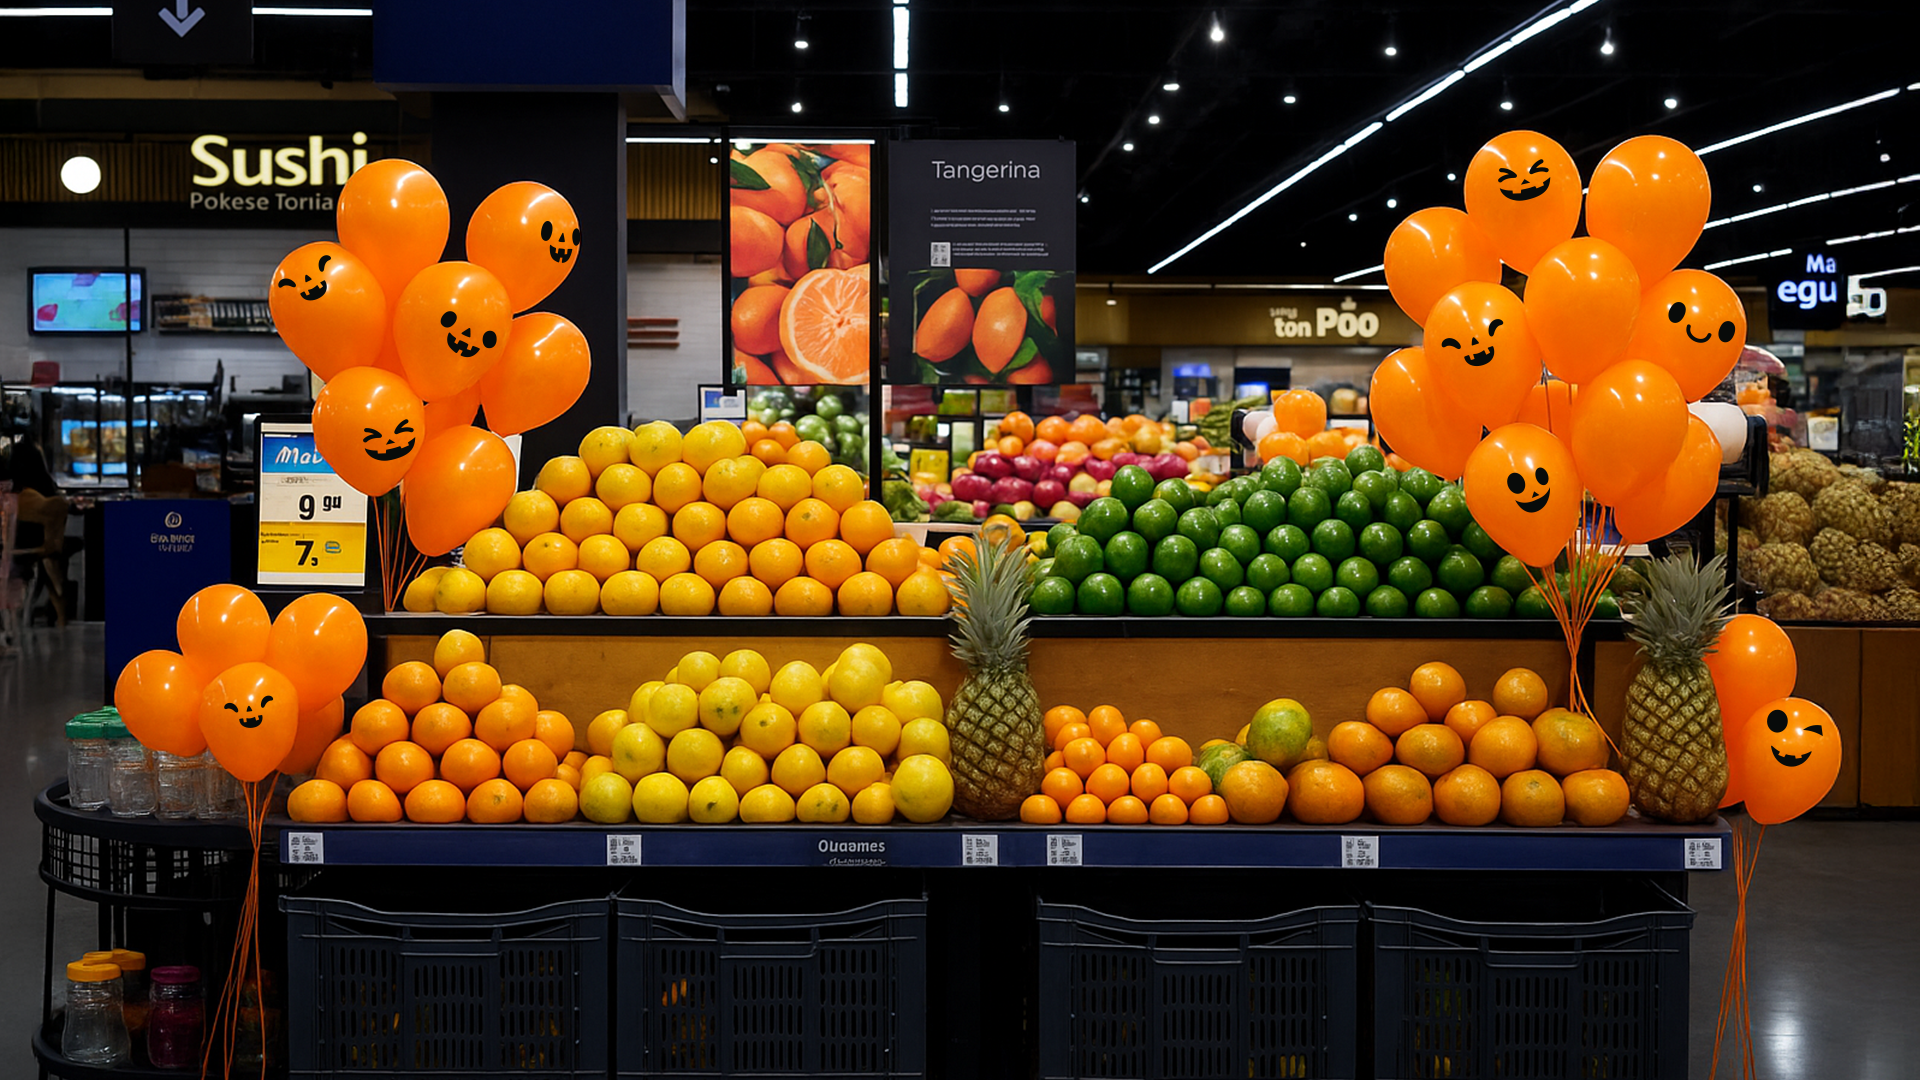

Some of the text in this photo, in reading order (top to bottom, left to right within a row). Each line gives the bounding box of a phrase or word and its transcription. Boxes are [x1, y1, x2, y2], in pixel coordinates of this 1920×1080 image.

[191, 131, 367, 187] Sushi
[931, 160, 1041, 182] Tangerina
[190, 192, 270, 211] Pokese
[1806, 253, 1837, 273] Ma
[1274, 317, 1312, 337] ton
[299, 494, 315, 520] 9
